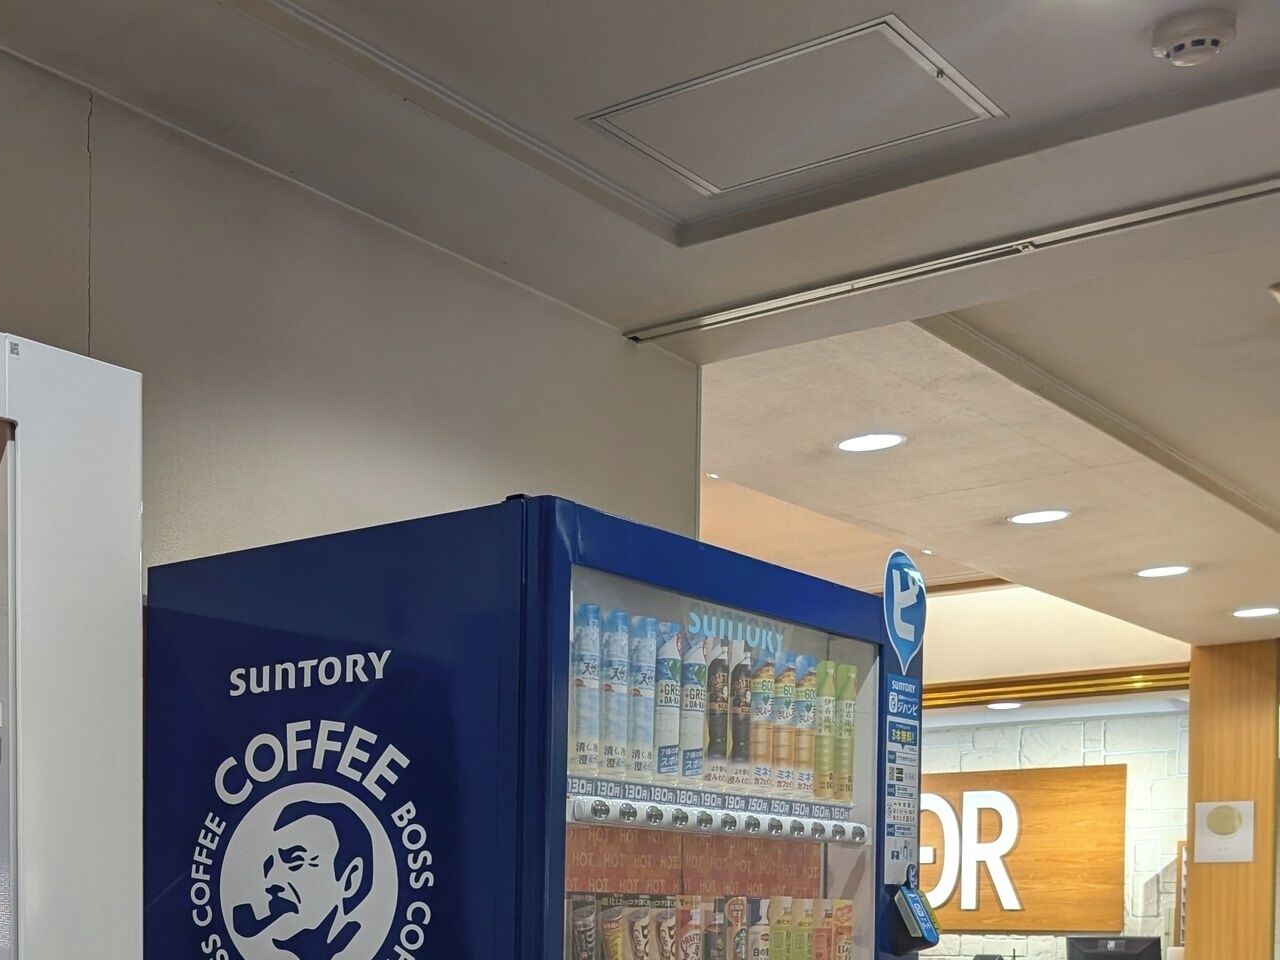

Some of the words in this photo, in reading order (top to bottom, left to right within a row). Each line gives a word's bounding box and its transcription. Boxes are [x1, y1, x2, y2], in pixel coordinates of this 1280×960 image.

[688, 605, 785, 653] SUNTORY
[228, 649, 393, 697] SUNTORY
[891, 679, 915, 694] SUNTORY
[214, 718, 411, 805] COFFEE
[190, 811, 227, 928] COFFEE
[391, 800, 435, 890] BOSS
